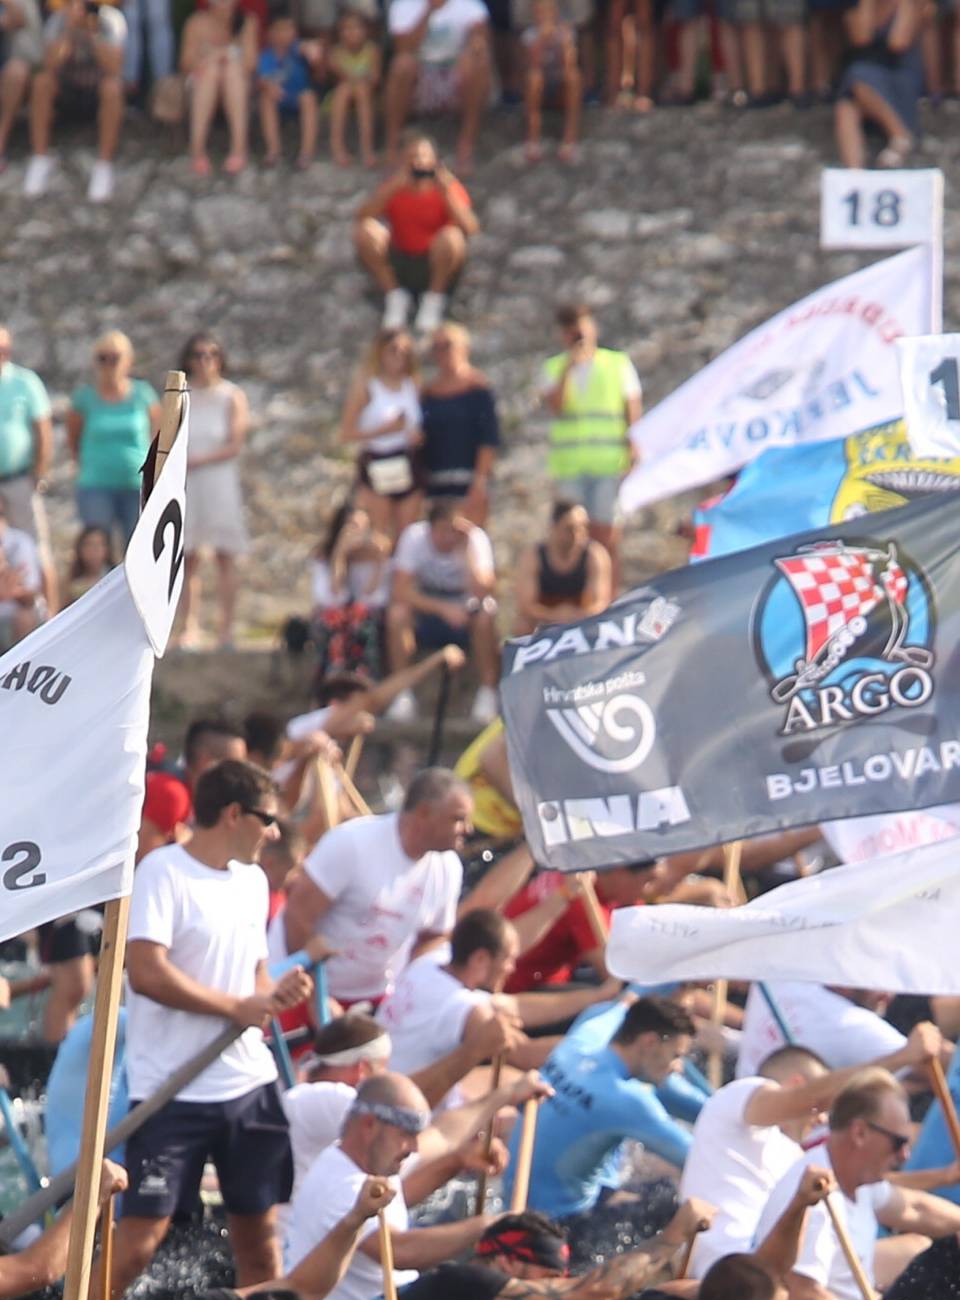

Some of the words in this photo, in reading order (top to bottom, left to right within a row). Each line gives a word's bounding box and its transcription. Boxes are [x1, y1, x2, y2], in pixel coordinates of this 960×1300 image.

[841, 188, 903, 228] 18
[152, 498, 185, 605] 2
[511, 614, 638, 674] PAN
[543, 680, 605, 703] Hrvatska
[782, 667, 933, 734] ARGO
[765, 740, 960, 801] BJELOVAR
